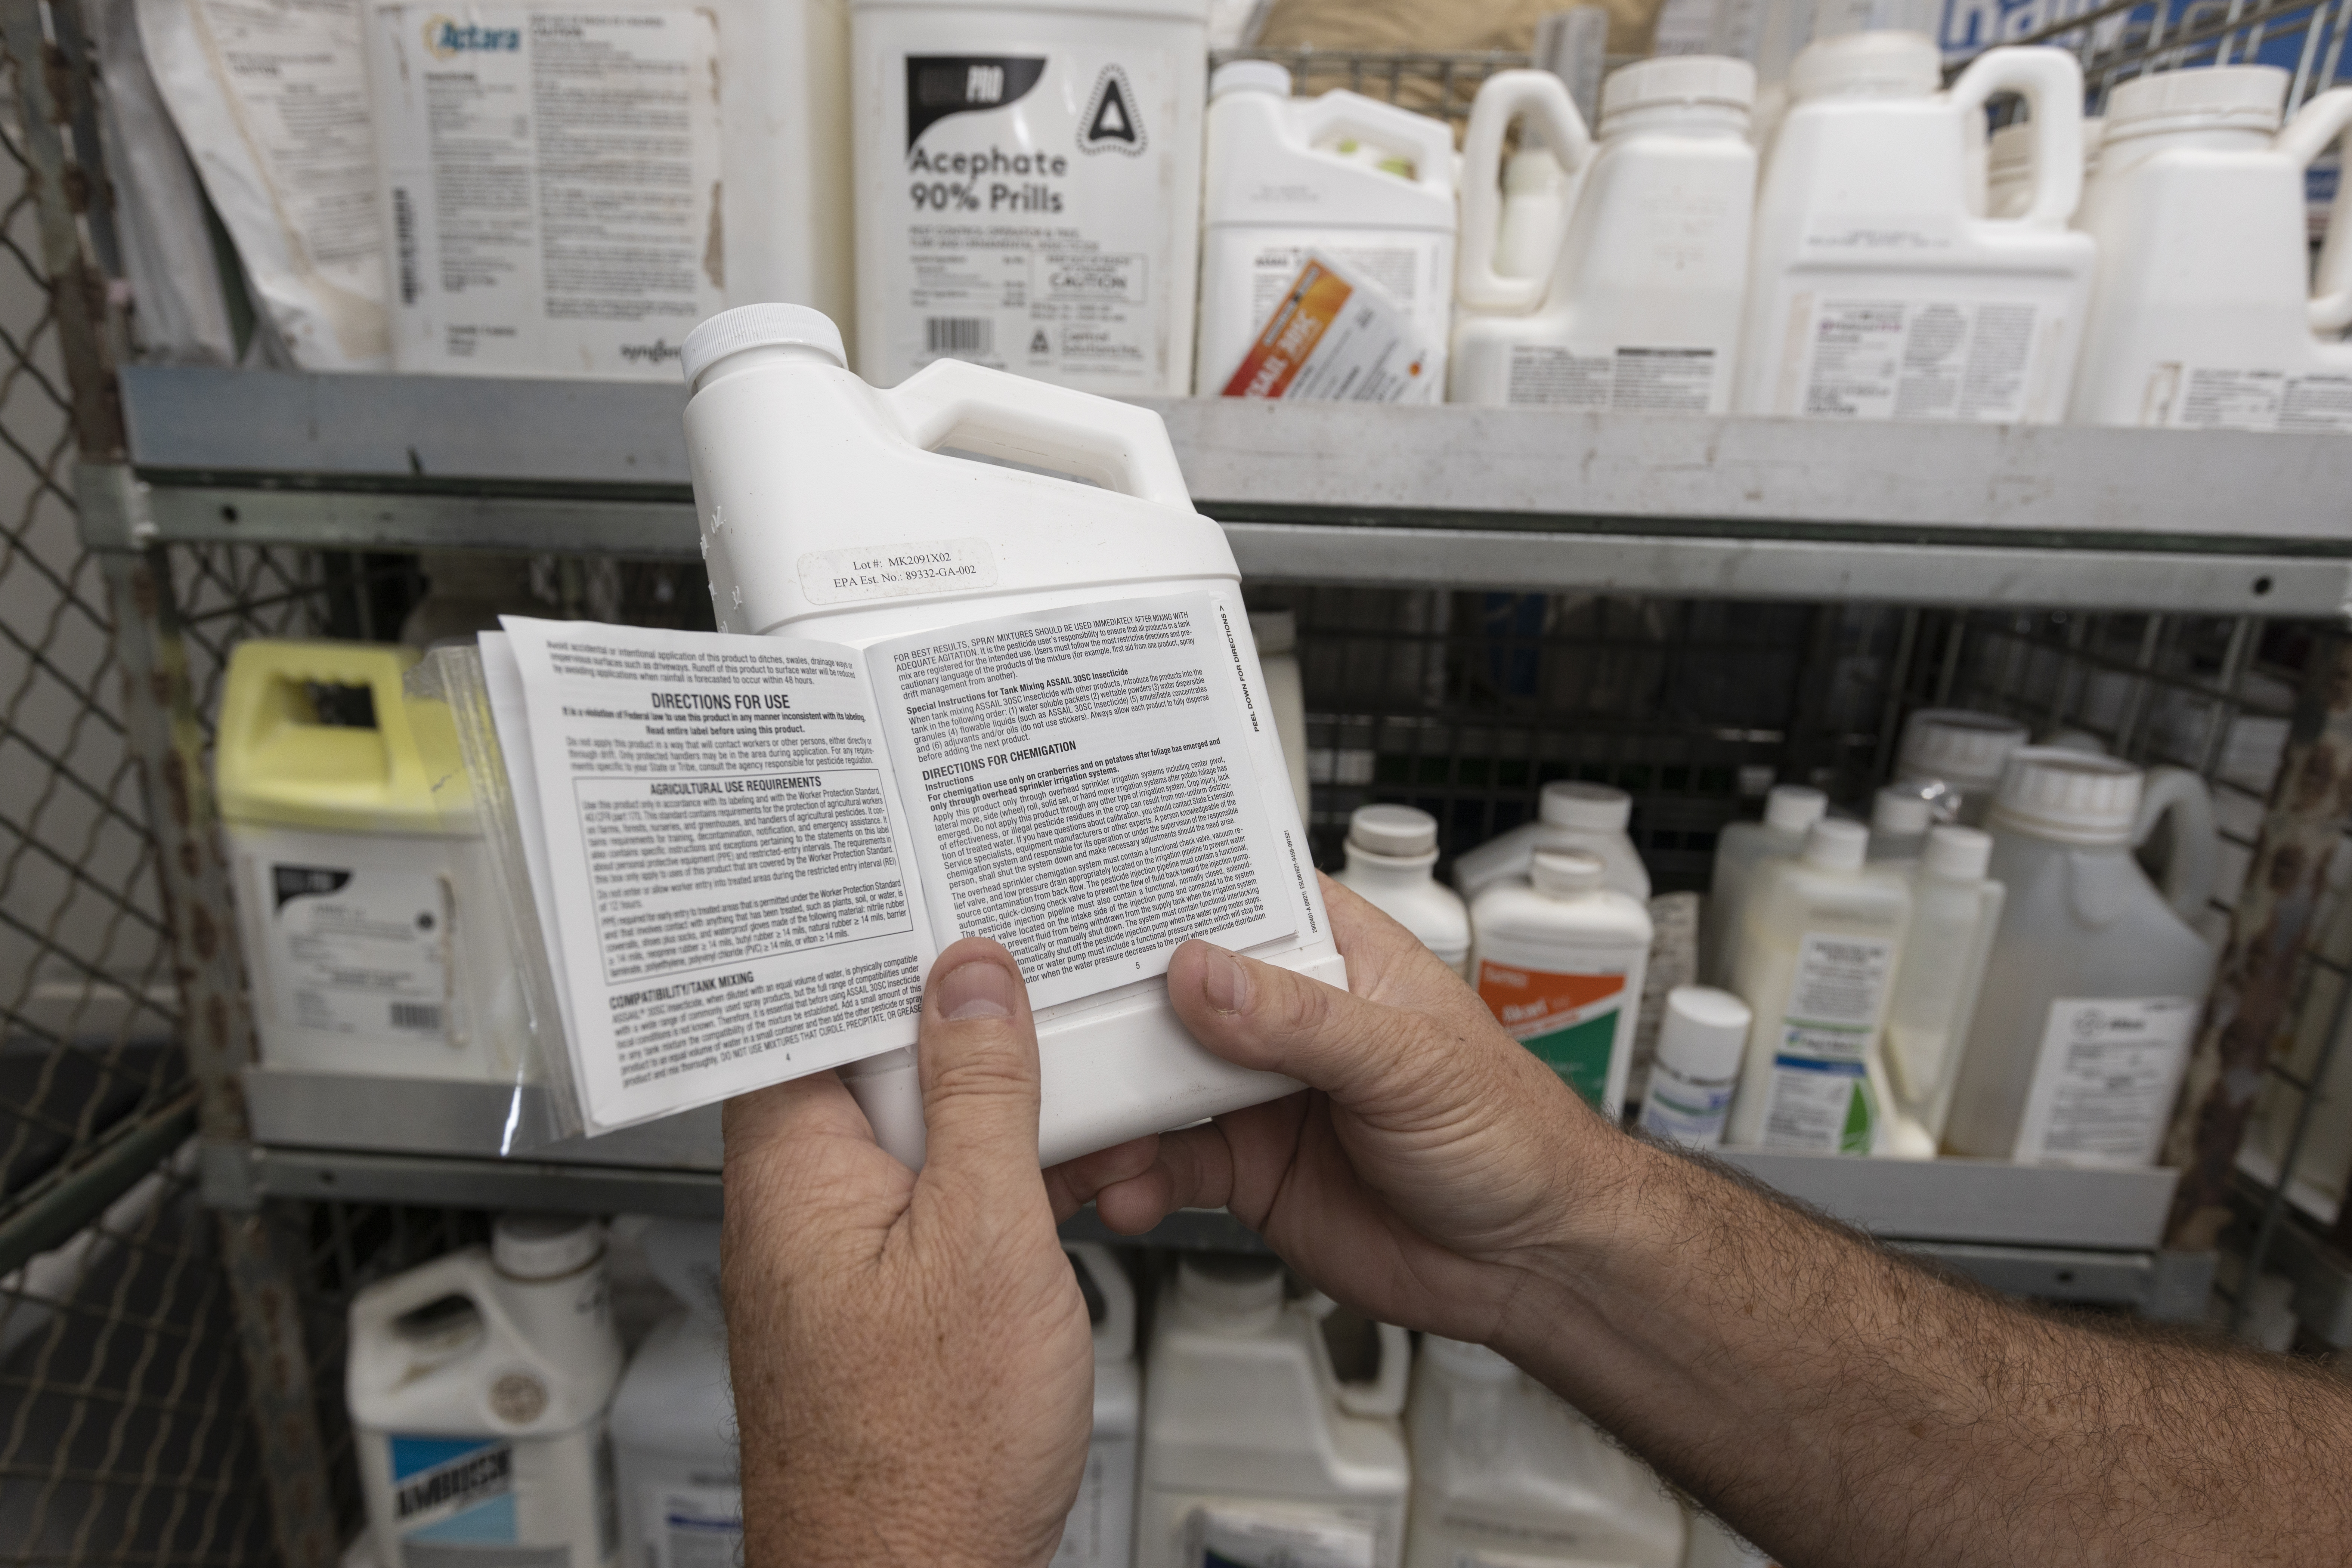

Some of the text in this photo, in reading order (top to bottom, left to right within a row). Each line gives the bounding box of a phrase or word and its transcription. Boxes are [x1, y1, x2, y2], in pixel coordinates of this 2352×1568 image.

[910, 146, 1068, 179] Acephate
[910, 183, 1064, 214] 90% Prills
[853, 552, 951, 571] Lot #: MK2091X02
[833, 578, 858, 588] EPA
[861, 574, 879, 585] Est.
[905, 565, 976, 581] 89332-GA-002
[894, 653, 910, 662] FOR
[911, 647, 930, 658] BEST
[933, 641, 969, 654] RESULTS,
[971, 635, 994, 646] SPRAY
[997, 630, 1033, 642] MIXTURES
[1035, 625, 1062, 636] SHOULD
[1074, 621, 1092, 630] USED
[1093, 616, 1133, 628] IMMEDIATELY
[1152, 613, 1172, 622] MIXING
[1173, 611, 1188, 619] WITH
[811, 657, 835, 668] drainage
[835, 661, 848, 669] ways
[1221, 613, 1260, 732] PEEL DOWN FOR DIRECTIONS
[651, 692, 790, 709] DIRECTIONS FOR USE
[906, 701, 936, 715] Special
[938, 693, 986, 708] Instructions
[999, 686, 1019, 695] Tank
[1019, 682, 1045, 692] Mixing
[1046, 677, 1072, 687] ASSAIL
[1073, 673, 1091, 683] 30SC
[1092, 668, 1128, 680] Insecticide
[781, 712, 822, 720] inconsistent
[844, 712, 866, 723] labeling.
[709, 726, 734, 735] before
[736, 726, 757, 736] using
[758, 726, 773, 734] this
[774, 725, 805, 735] product.
[922, 740, 1076, 780] DIRECTIONS FOR CHEMIGATION
[927, 794, 941, 802] For
[943, 783, 992, 798] chemigation
[993, 779, 1007, 788] use
[1009, 775, 1024, 784] only
[1037, 765, 1079, 778] cranberries
[1080, 760, 1093, 770] and
[1105, 754, 1134, 767] potatoes
[1135, 751, 1149, 759] after
[1151, 748, 1171, 756] foliage
[1183, 739, 1208, 751] emerged
[1209, 737, 1220, 746] and
[651, 776, 821, 795] AGRICULTURAL USE REQUIREMENTS
[798, 787, 881, 800] Worker Protection Standard,
[925, 776, 974, 791] Instructions
[930, 767, 1119, 811] only through overhead sprinkler irrigation systems.
[933, 811, 953, 822] Apply
[972, 801, 1000, 814] product
[1003, 797, 1017, 806] only
[1019, 791, 1046, 803] through
[1049, 783, 1079, 797] overhead
[1081, 779, 1109, 791] sprinkler
[1111, 773, 1139, 784] irrigation
[1141, 768, 1164, 779] systems
[1166, 764, 1190, 773] including
[1191, 760, 1207, 768] center
[1209, 756, 1225, 766] pivot,
[944, 858, 972, 869] Service
[974, 848, 1014, 864] specialists,
[1016, 838, 1053, 853] equipment
[1054, 829, 1102, 844] manufacturers
[1111, 823, 1127, 832] other
[1129, 817, 1154, 828] experts.
[1160, 812, 1179, 823] person
[1179, 802, 1219, 816] knowledgeable
[808, 845, 894, 862] Worker Protection Standard.
[807, 857, 896, 875] restricted entry interval (REI)
[1284, 830, 1317, 933] 2902401-A (0921) ESL061621-9459-091521
[838, 900, 904, 916] material: nitrile rubber
[1022, 966, 1035, 974] line
[1045, 958, 1065, 968] water
[1067, 952, 1086, 964] pump
[1087, 946, 1105, 957] must
[1106, 940, 1129, 952] include
[1136, 930, 1166, 944] functional
[1167, 924, 1193, 937] pressure
[1194, 917, 1213, 928] switch
[1213, 913, 1230, 923] which
[1231, 909, 1240, 918] will
[1241, 907, 1253, 915] stop
[852, 954, 917, 976] physically compatible
[1136, 961, 1140, 969] 5
[718, 971, 754, 988] MIXING
[829, 974, 920, 1001] using ASSAIL 30SC Insecticide
[846, 1004, 922, 1029] PRECIPITATE, OR GREASE
[786, 1054, 791, 1062] 4
